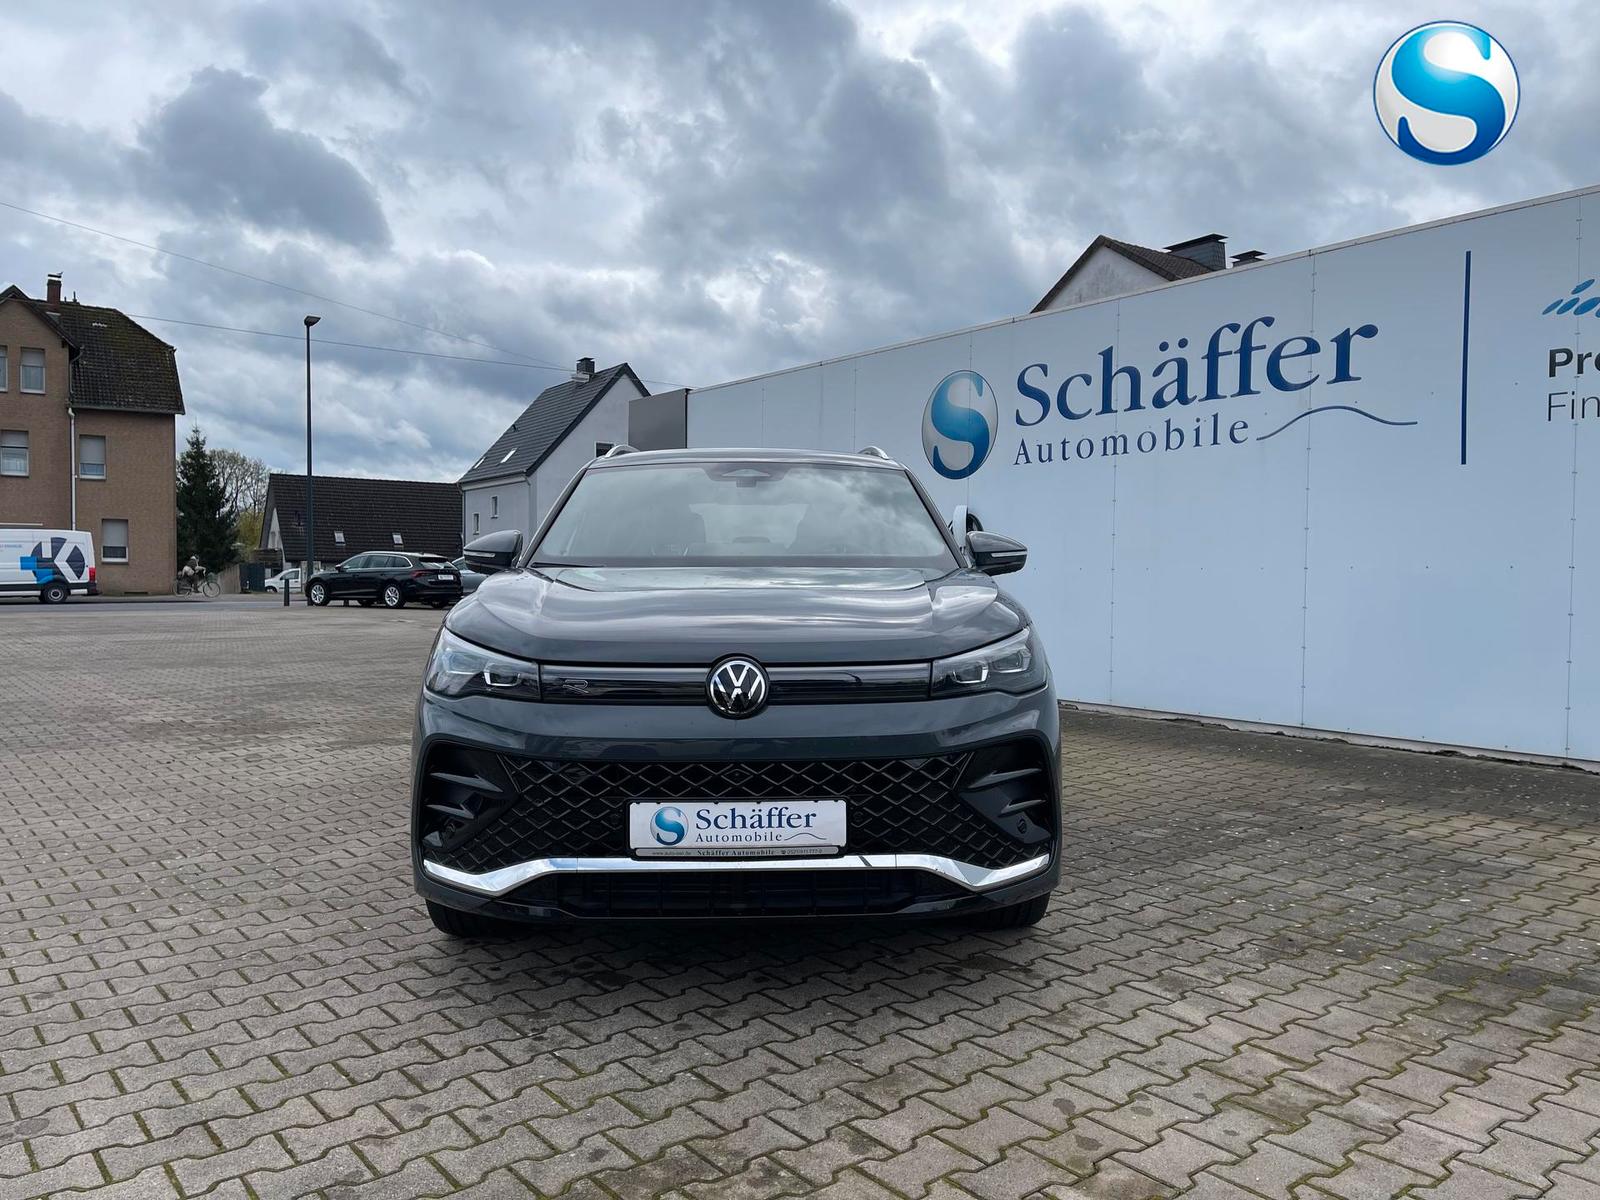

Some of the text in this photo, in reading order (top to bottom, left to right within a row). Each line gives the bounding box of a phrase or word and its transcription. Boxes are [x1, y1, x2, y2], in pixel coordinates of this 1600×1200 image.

[1015, 316, 1379, 427] Schäffer
[1013, 412, 1249, 465] Automobile
[695, 806, 817, 830] Schäffer
[695, 832, 783, 843] Automobile
